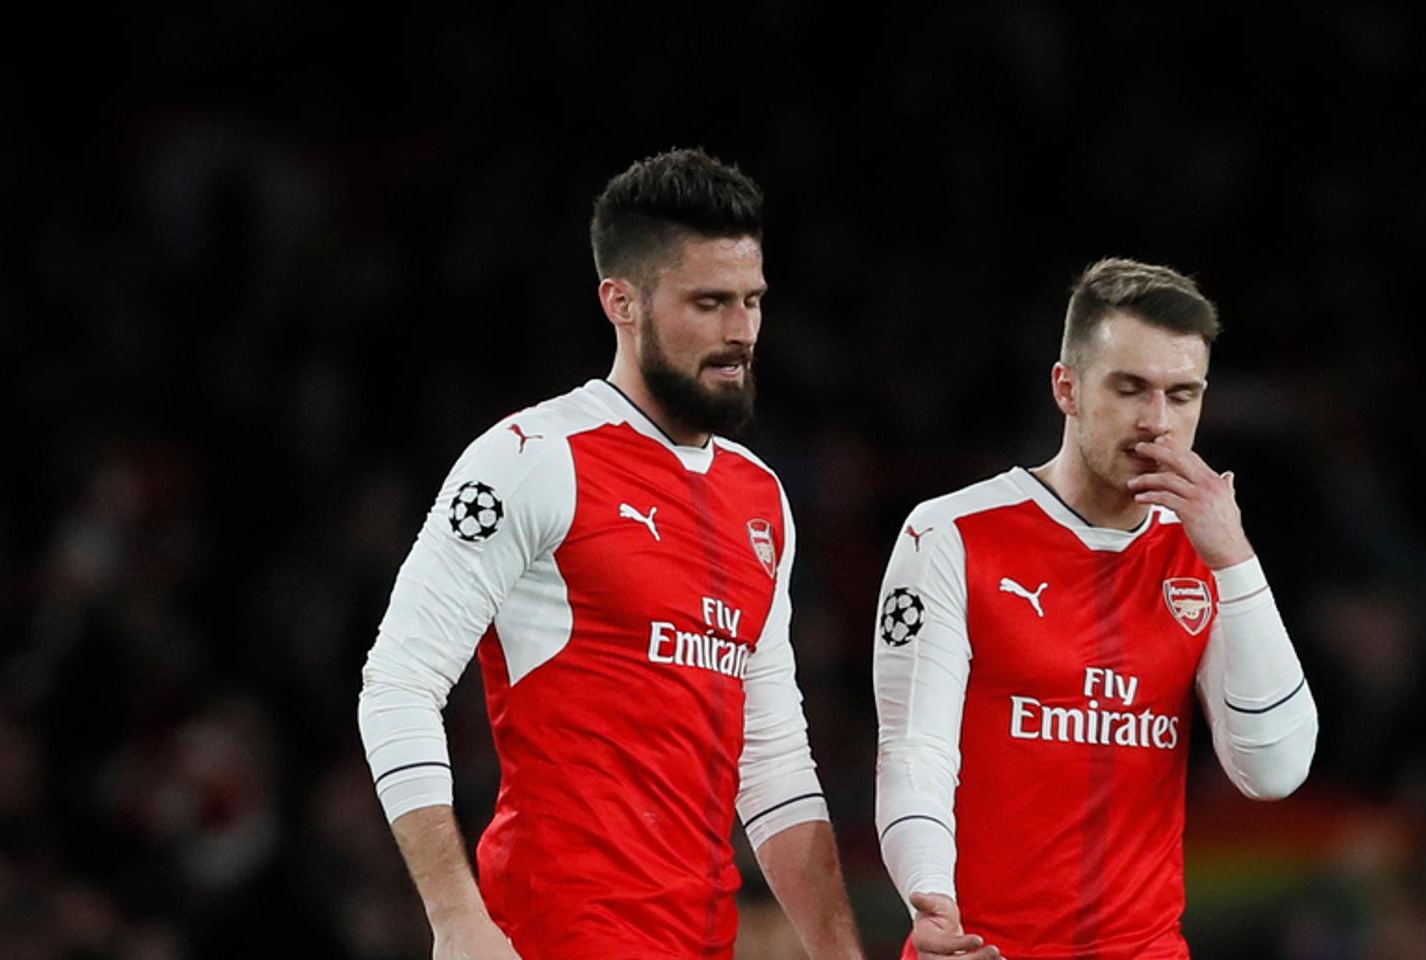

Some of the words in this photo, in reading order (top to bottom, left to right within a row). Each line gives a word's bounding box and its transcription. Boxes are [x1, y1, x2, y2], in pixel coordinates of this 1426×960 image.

[702, 596, 742, 638] Fly
[1084, 667, 1139, 706] Fly
[1010, 695, 1179, 750] Emirates
